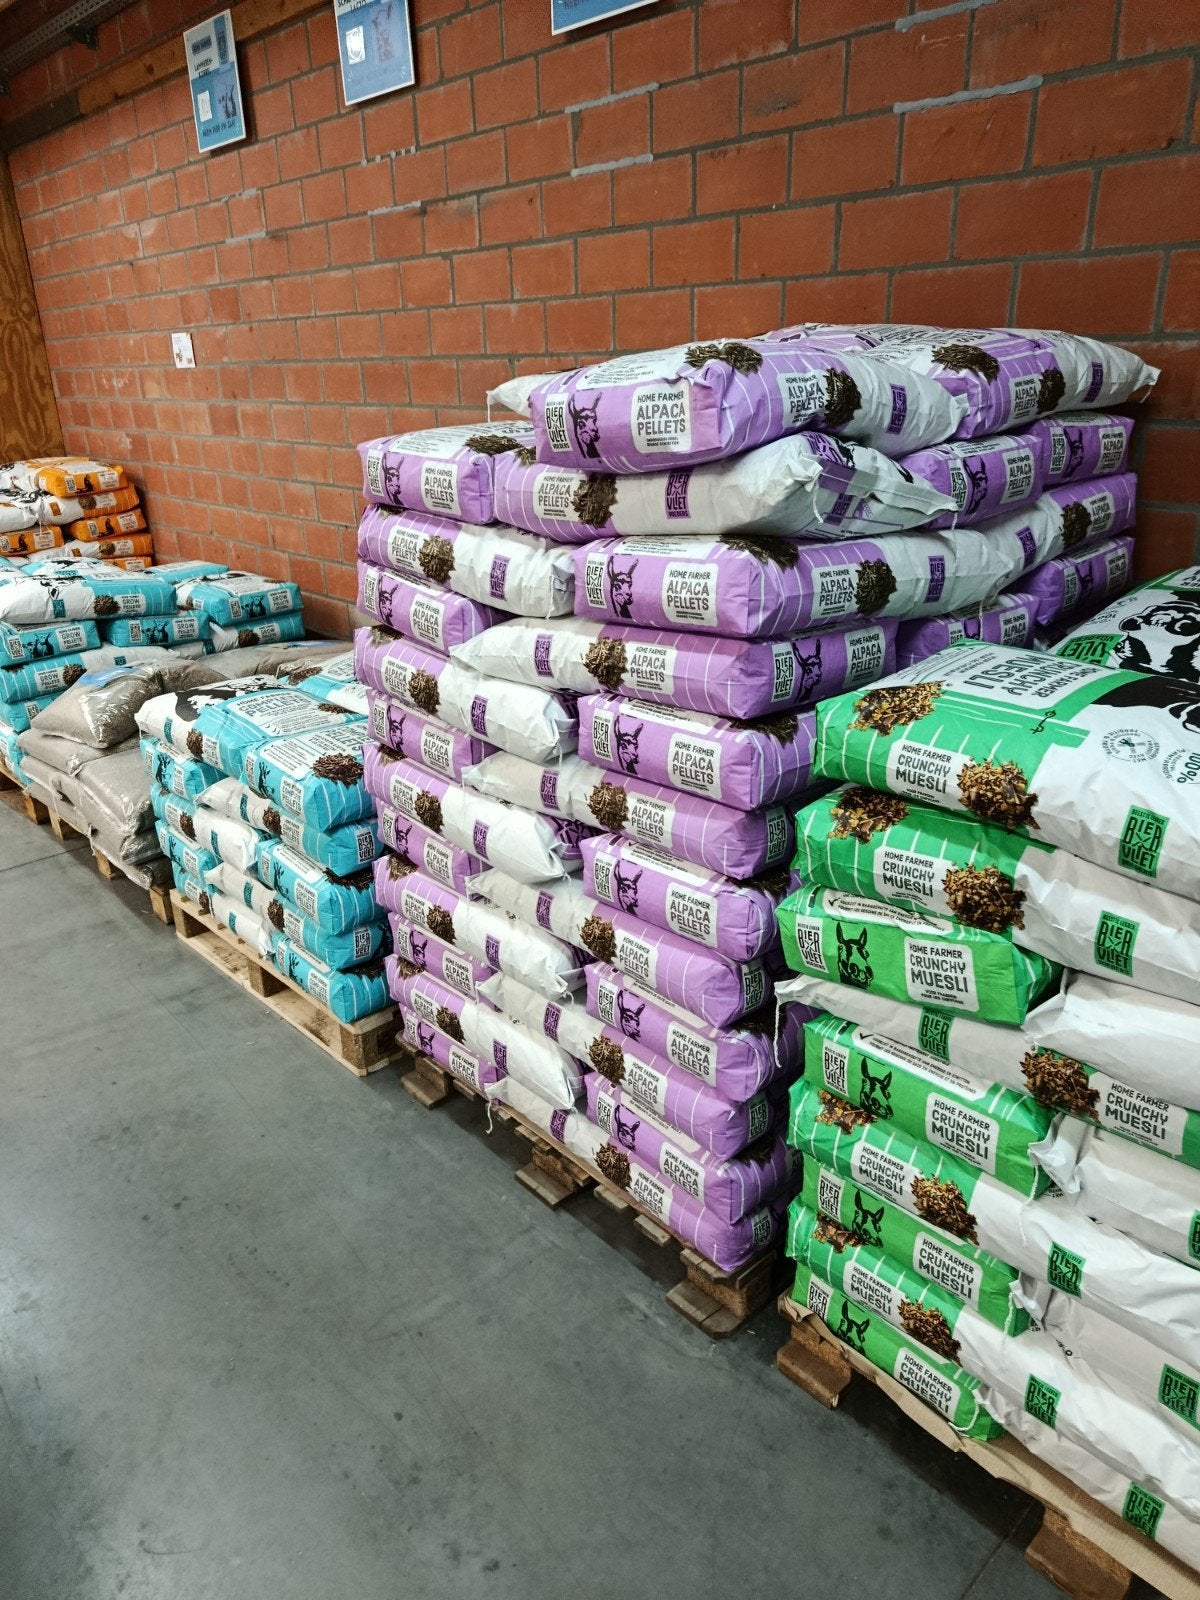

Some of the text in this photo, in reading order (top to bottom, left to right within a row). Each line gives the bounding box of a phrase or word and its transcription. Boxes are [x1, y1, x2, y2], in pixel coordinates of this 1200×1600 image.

[637, 391, 684, 403] HOME FARMER
[1015, 386, 1038, 399] ALPACA
[546, 407, 564, 430] BIER
[637, 402, 686, 421] ALPACA
[549, 429, 567, 443] VLIET
[638, 418, 686, 436] PELLETS
[1009, 464, 1032, 479] ALPACA
[424, 476, 453, 491] ALPACA
[538, 482, 571, 498] ALPACA
[667, 473, 688, 496] BIER
[1007, 477, 1031, 491] PELLETS
[425, 487, 454, 502] PELLETS
[538, 496, 570, 508] PELLETS
[667, 496, 687, 510] VLIET
[392, 536, 418, 553] ALPACA
[392, 547, 416, 561] PELLETS
[670, 570, 687, 579] HOME
[667, 580, 710, 596] ALPACA
[821, 579, 855, 594] ALPACA
[668, 595, 709, 610] PELLETS
[819, 592, 853, 606] PELLETS
[413, 608, 439, 627] ALPACA
[62, 632, 80, 640] GROW
[413, 620, 439, 637] PELLETS
[1004, 623, 1026, 638] ALPACA
[850, 633, 880, 646] HOME FARMER
[631, 654, 666, 670] ALPACA
[852, 643, 882, 662] ALPACA
[384, 666, 407, 683] ALPACA
[631, 667, 664, 682] PELLETS
[775, 657, 793, 680] BIER
[851, 657, 881, 675] PELLETS
[963, 654, 1055, 689] MUESLI
[775, 678, 793, 693] VLIET
[1001, 661, 1082, 695] CRUNCHY
[423, 740, 448, 757] ALPACA
[424, 751, 449, 767] PELLETS
[675, 740, 715, 757] HOME FARMER
[902, 744, 951, 763] HOME FARMER
[673, 750, 714, 772] ALPACA
[898, 754, 951, 777] CRUNCHY
[673, 764, 714, 784] PELLETS
[896, 767, 946, 794] MUESLI
[632, 806, 664, 824] ALPACA
[632, 817, 664, 837] PELLETS
[1123, 817, 1162, 852] BIER
[426, 850, 449, 869] ALPACA
[884, 851, 934, 869] HOME FARMER
[1122, 844, 1155, 869] VLIET
[883, 861, 934, 882] CRUNCHY
[883, 873, 934, 897] MUESLI
[405, 900, 426, 915] ALPACA
[671, 890, 710, 909] HOME FARMER
[670, 900, 711, 923] ALPACA
[671, 913, 710, 935] PELLETS
[623, 937, 650, 954] HOME FARMER
[798, 929, 820, 953] BIER
[1097, 921, 1133, 957] BIER
[620, 944, 649, 965] ALPACA
[802, 949, 822, 964] VLIET
[909, 943, 963, 959] HOME FARMER
[1097, 946, 1129, 969] VLIET
[445, 964, 470, 983] ALPACA
[619, 957, 649, 977] PELLETS
[910, 954, 966, 974] CRUNCHY
[745, 971, 763, 996] BIER
[911, 968, 968, 993] MUESLI
[921, 1015, 949, 1044] BIER
[671, 1038, 709, 1064] ALPACA
[673, 1029, 710, 1052] HOME FARMER
[920, 1039, 946, 1056] VLIET
[452, 1058, 475, 1077] ALPACA
[633, 1062, 659, 1082] HOME FARMER
[671, 1052, 709, 1075] PELLETS
[825, 1052, 845, 1080] BIER
[628, 1070, 658, 1093] ALPACA
[826, 1072, 845, 1088] VLIET
[628, 1079, 658, 1104] PELLETS
[1112, 1083, 1170, 1112] HOME FARMER
[934, 1100, 990, 1131] HOME FARMER
[1107, 1093, 1168, 1125] CRUNCHY
[932, 1110, 991, 1143] CRUNCHY
[1105, 1105, 1166, 1140] MUESLI
[932, 1124, 988, 1160] MUESLI
[666, 1149, 699, 1177] HOME FARMER
[860, 1155, 905, 1182] CRUNCHY
[862, 1146, 904, 1171] HOME FARMER
[639, 1172, 665, 1193] HOME FARMER
[664, 1156, 699, 1188] ALPACA
[664, 1168, 699, 1197] PELLETS
[859, 1166, 902, 1196] MUESLI
[635, 1180, 663, 1205] ALPACA
[820, 1180, 840, 1206] BIER
[923, 1239, 974, 1274] HOME FARMER
[920, 1250, 974, 1286] CRUNCHY
[851, 1274, 892, 1304] CRUNCHY
[853, 1266, 892, 1294] HOME FARMER
[919, 1261, 972, 1300] MUESLI
[851, 1284, 891, 1316] MUESLI
[904, 1354, 952, 1392] HOME FARMER
[899, 1373, 949, 1414] MUESLI
[900, 1362, 952, 1407] CRUNCHY
[1162, 1375, 1198, 1416] BIER
[1127, 1490, 1162, 1531] BIER
